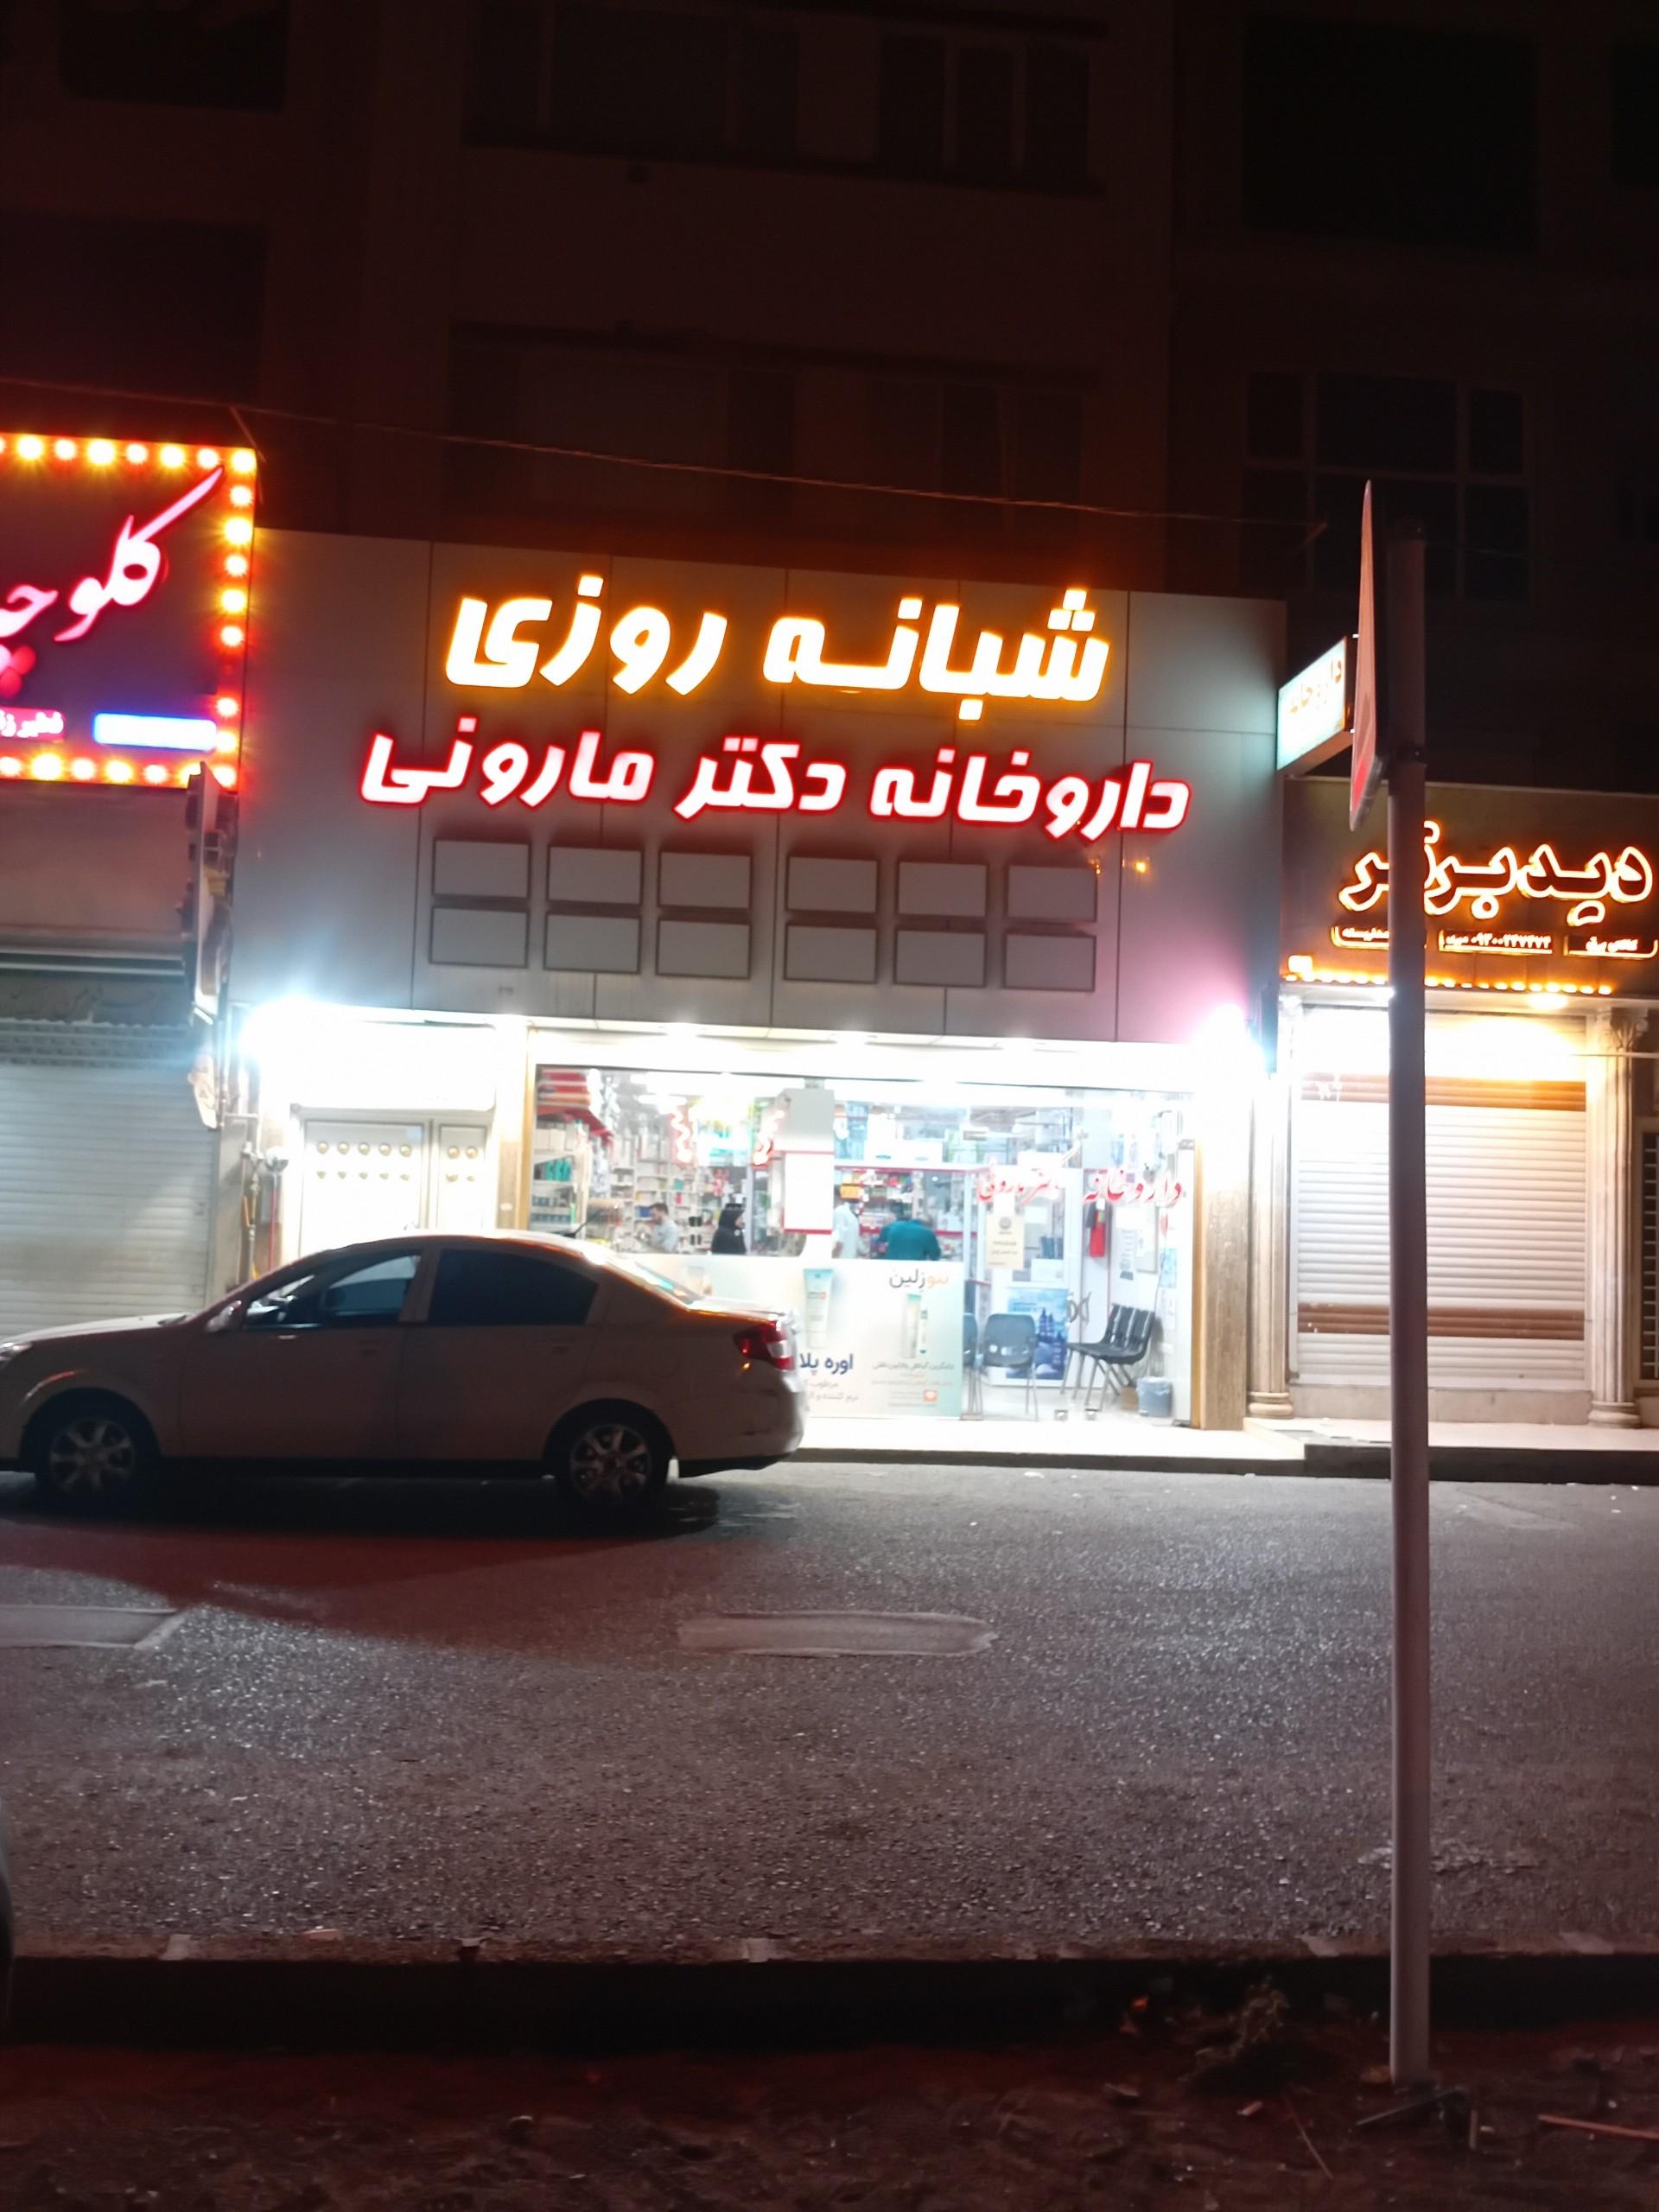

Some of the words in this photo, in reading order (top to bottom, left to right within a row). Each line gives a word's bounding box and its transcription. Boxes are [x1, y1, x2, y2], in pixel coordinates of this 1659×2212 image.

[445, 575, 728, 696] روزی
[762, 588, 1110, 721] شبانه
[361, 718, 653, 808] مارونی
[675, 737, 847, 819] دکتر
[869, 749, 1190, 841] داروخانه
[1083, 1167, 1184, 1205] داروخانه
[824, 1353, 854, 1376] اوره
